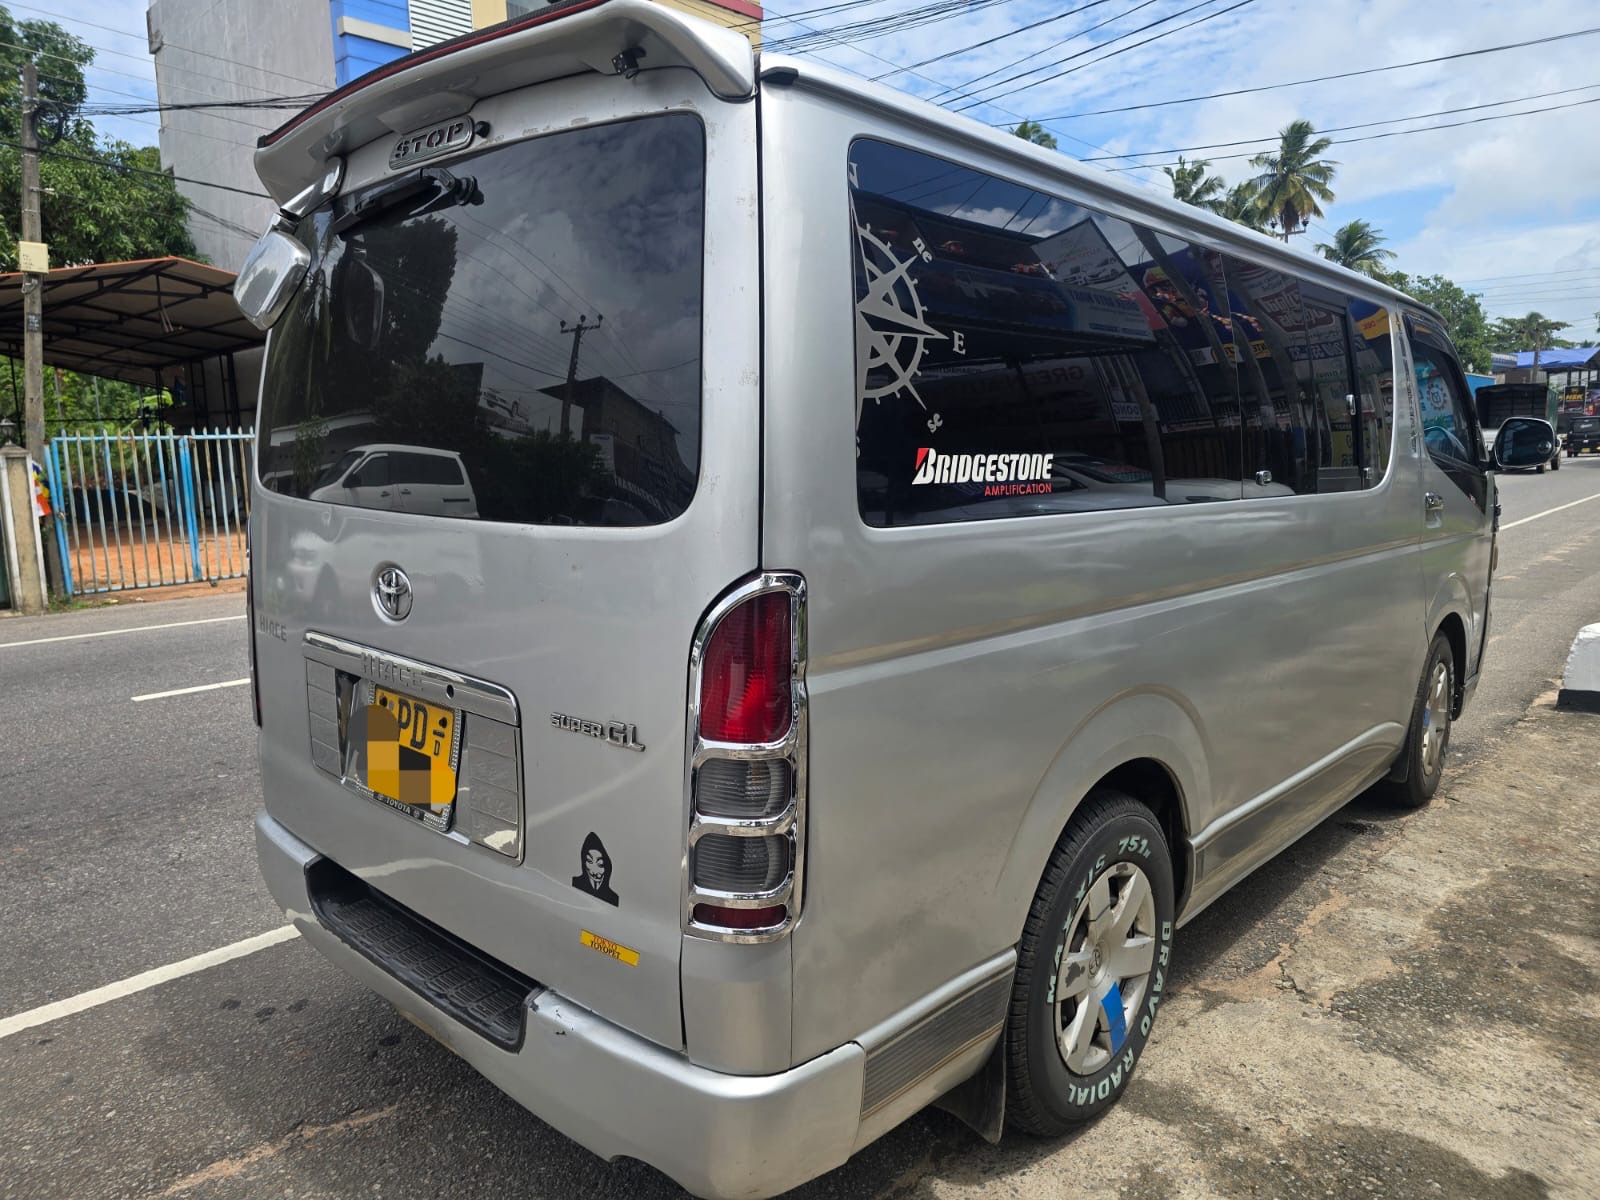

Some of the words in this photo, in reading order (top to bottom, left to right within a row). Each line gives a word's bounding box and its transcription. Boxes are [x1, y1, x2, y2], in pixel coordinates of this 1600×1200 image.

[394, 122, 465, 158] STOP
[952, 330, 966, 355] E
[912, 448, 1054, 485] BRIDGESTONE
[984, 483, 1052, 497] AMPLIFICATION
[551, 712, 604, 738] SUPER
[606, 720, 646, 752] GL
[386, 797, 411, 814] TOYOTA
[590, 941, 620, 960] TOYOPET
[1140, 921, 1172, 1037] BRAVO
[1068, 1047, 1135, 1106] RADIAL
